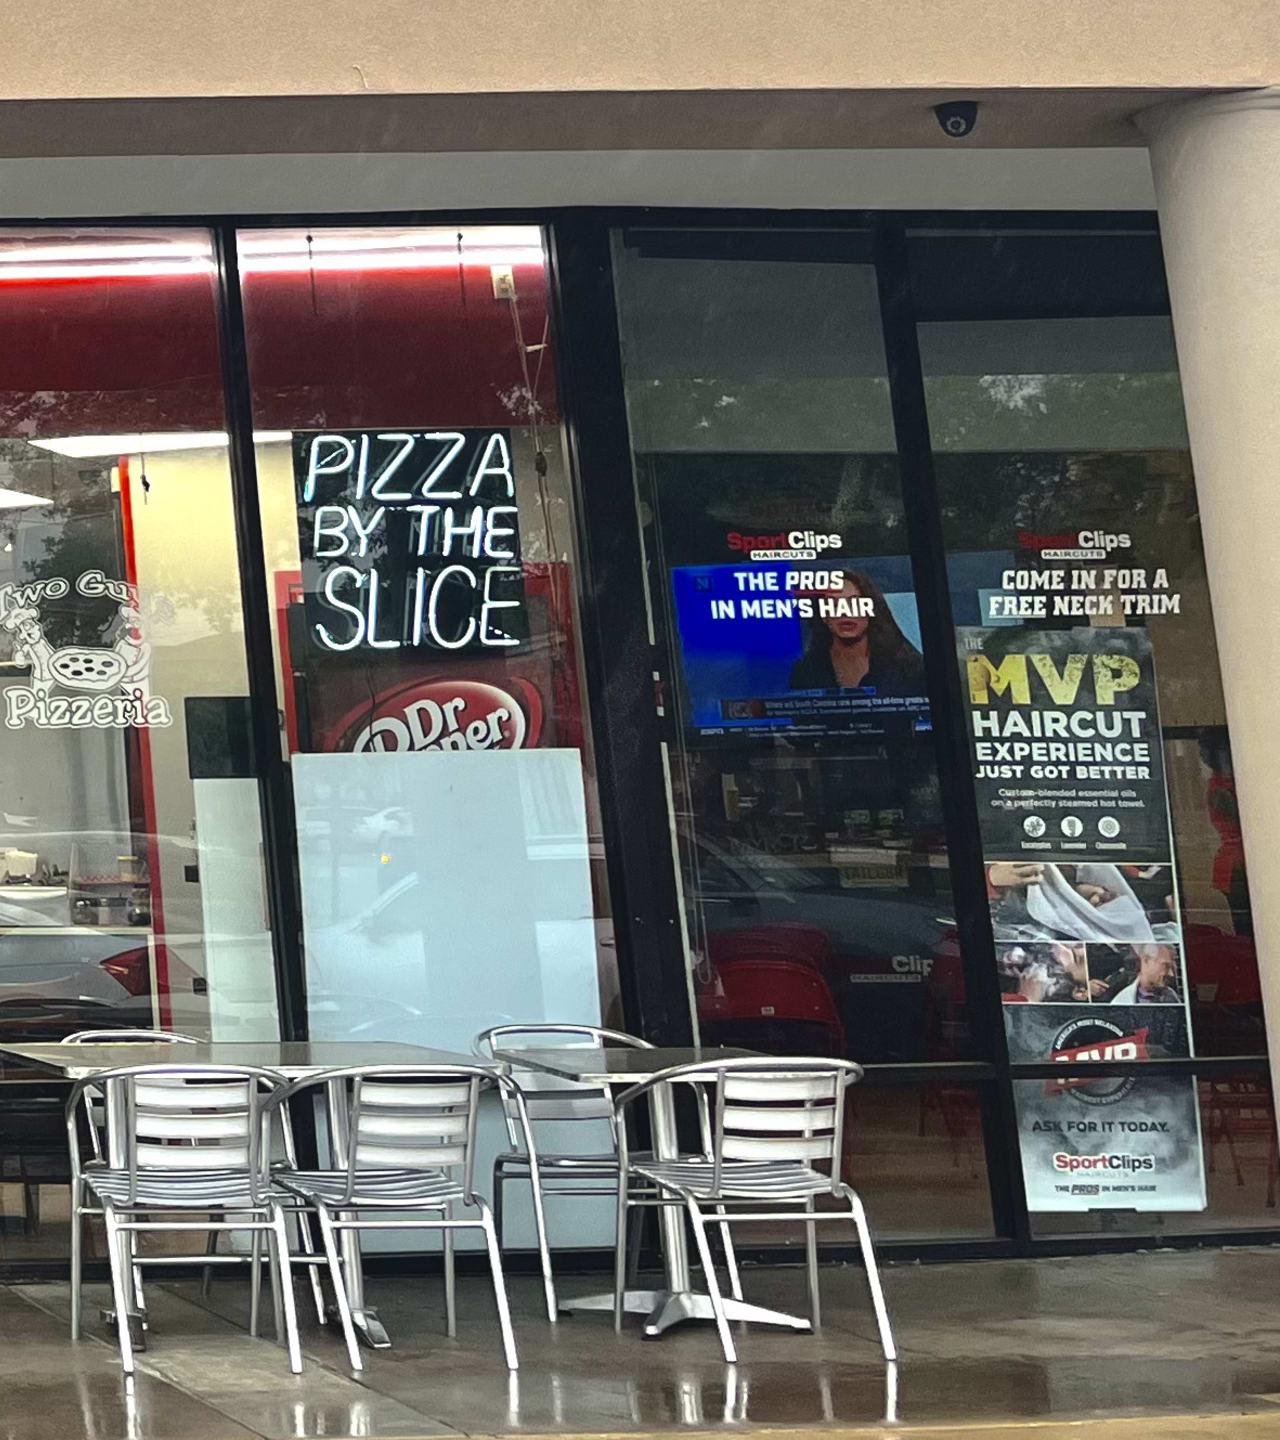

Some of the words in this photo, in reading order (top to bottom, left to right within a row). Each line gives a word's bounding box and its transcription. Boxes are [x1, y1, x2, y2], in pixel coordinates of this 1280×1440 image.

[304, 432, 514, 502] PIZZA
[314, 505, 385, 558] BY
[407, 504, 518, 558] THE
[734, 572, 778, 591] THE
[786, 571, 844, 590] PROS
[1002, 570, 1065, 590] COME
[1071, 570, 1097, 589] IN
[1103, 569, 1147, 589] FOR
[1153, 569, 1169, 588] A
[316, 565, 520, 651] SLICE
[711, 600, 735, 619] IN
[742, 599, 813, 619] MEN'S
[818, 598, 875, 617] HAIR
[989, 596, 1046, 616] FREE
[1053, 596, 1113, 616] NECK
[1120, 594, 1181, 614] TRIM
[967, 654, 1140, 705] MVP
[3, 686, 173, 729] Pizzeria
[403, 697, 466, 745] Dr
[972, 711, 1146, 738] HAIRCUT
[975, 742, 1150, 762] EXPERIENCE
[975, 766, 1023, 778] JUST
[1030, 766, 1070, 778] GOT
[1076, 766, 1150, 779] BETTER
[1100, 798, 1116, 807] hot
[1032, 1121, 1063, 1132] ASK
[1068, 1121, 1097, 1132] FOR
[1102, 1121, 1115, 1132] IT
[1055, 1154, 1153, 1172] SportClips
[1072, 1184, 1099, 1193] PROS
